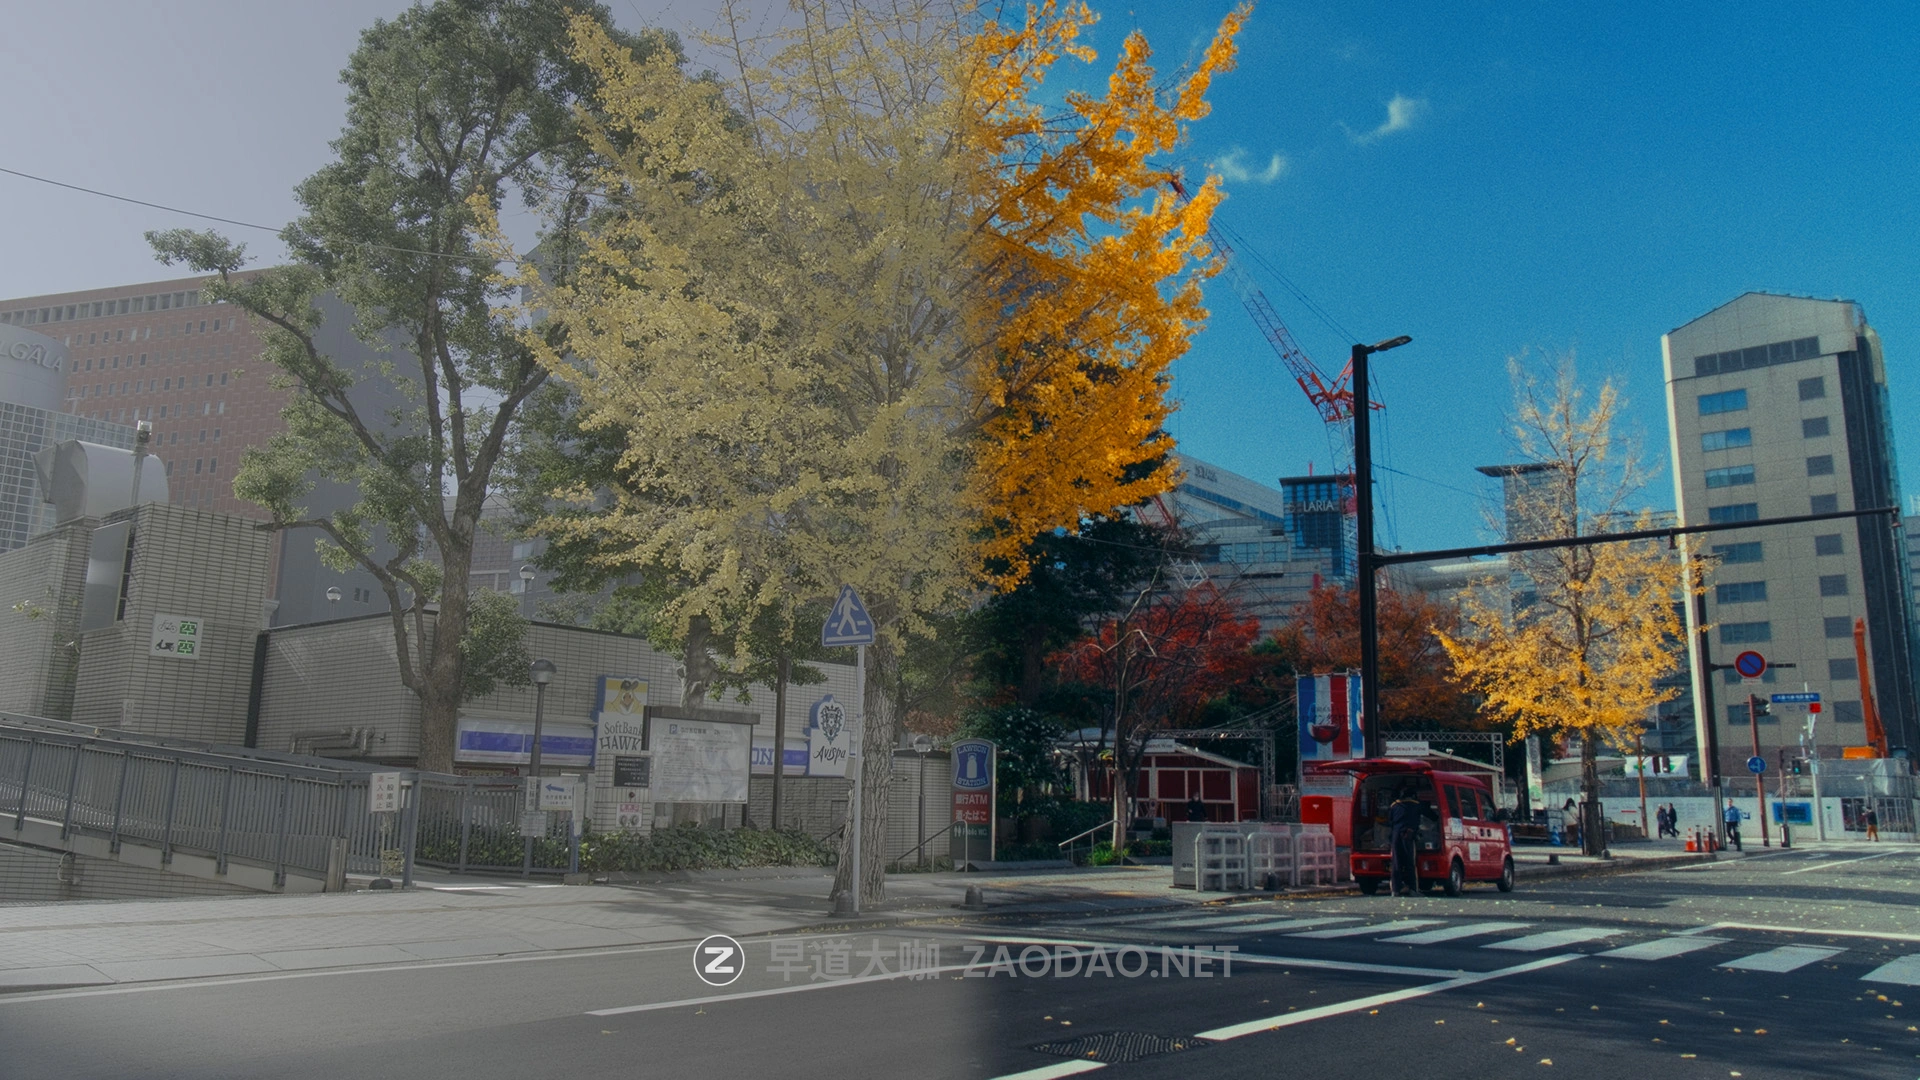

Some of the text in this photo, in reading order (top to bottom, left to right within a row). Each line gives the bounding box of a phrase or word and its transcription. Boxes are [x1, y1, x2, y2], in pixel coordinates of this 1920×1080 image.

[958, 744, 987, 754] LAWSON
[813, 746, 847, 765] Avispa
[957, 777, 987, 787] STATION
[955, 794, 988, 805] 銀行ATM
